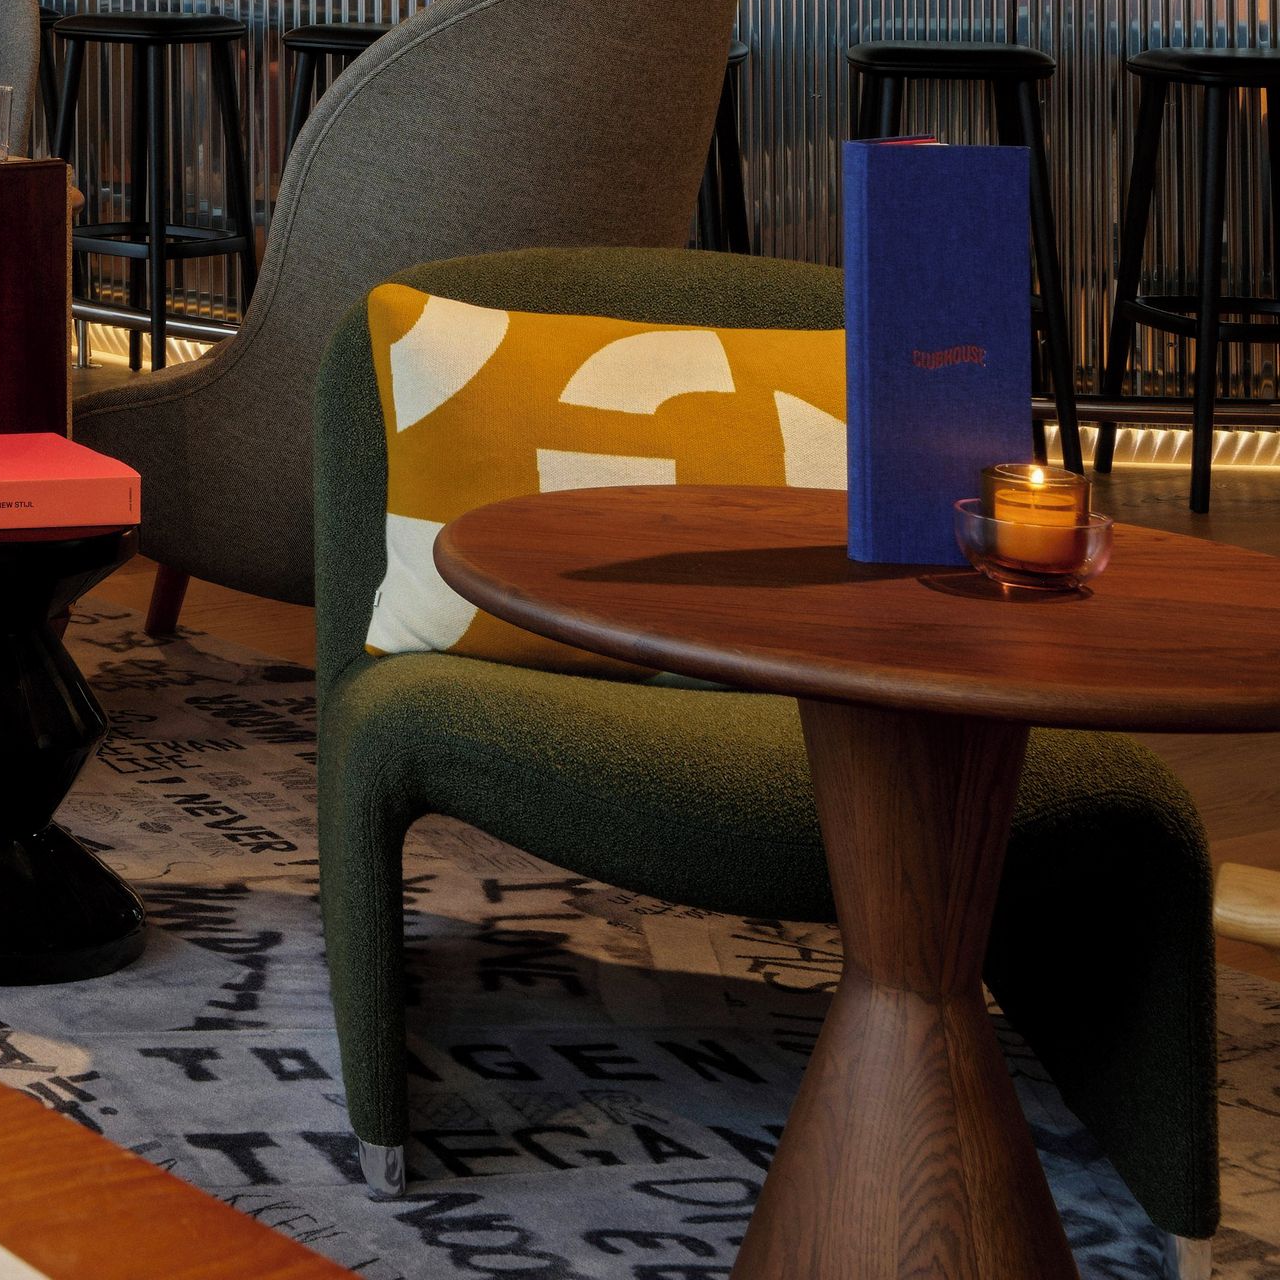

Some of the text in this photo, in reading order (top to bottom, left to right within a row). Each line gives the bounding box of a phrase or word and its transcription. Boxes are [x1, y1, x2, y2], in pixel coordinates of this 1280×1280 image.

[911, 344, 987, 370] CLUBHOUSE
[14, 500, 35, 509] STIJL
[162, 793, 299, 854] NEVER
